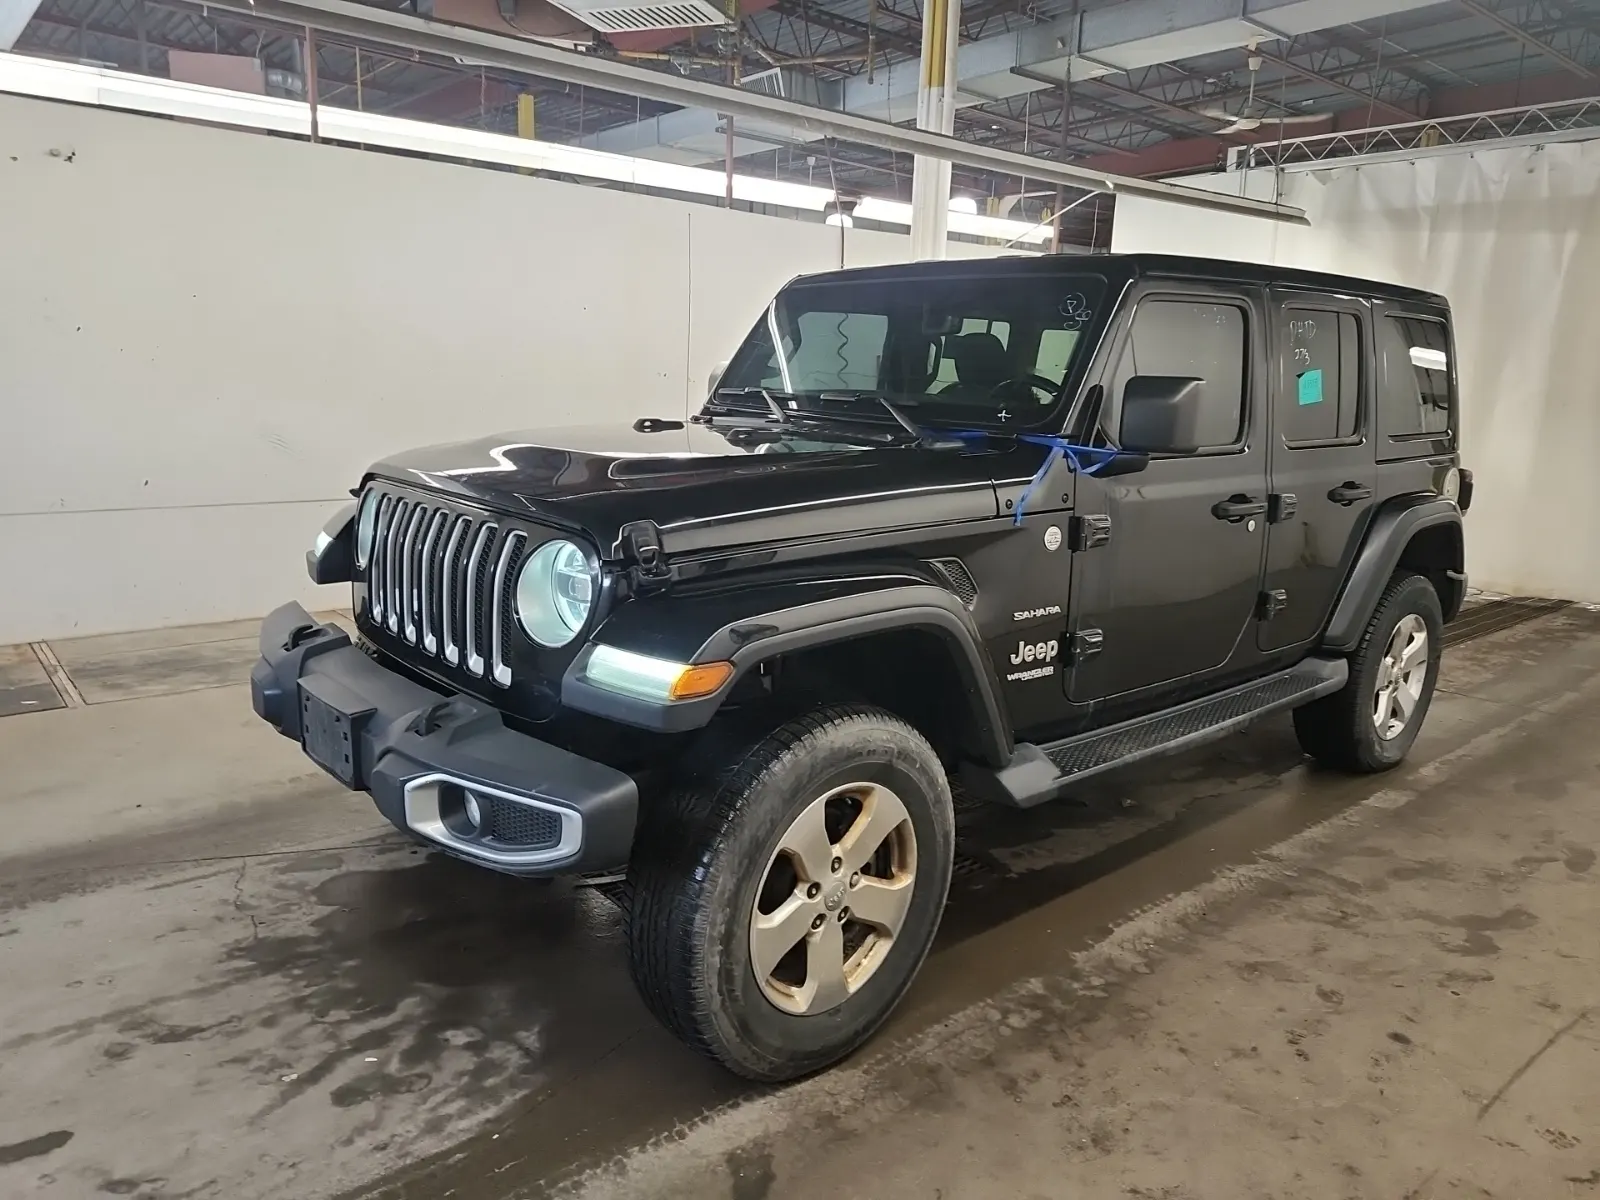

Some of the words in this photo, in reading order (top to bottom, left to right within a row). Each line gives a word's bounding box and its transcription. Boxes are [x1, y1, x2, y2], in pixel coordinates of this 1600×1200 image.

[1013, 605, 1062, 621] SAHARA
[1010, 639, 1059, 665] Jeep
[1006, 666, 1054, 681] WRANGLER
